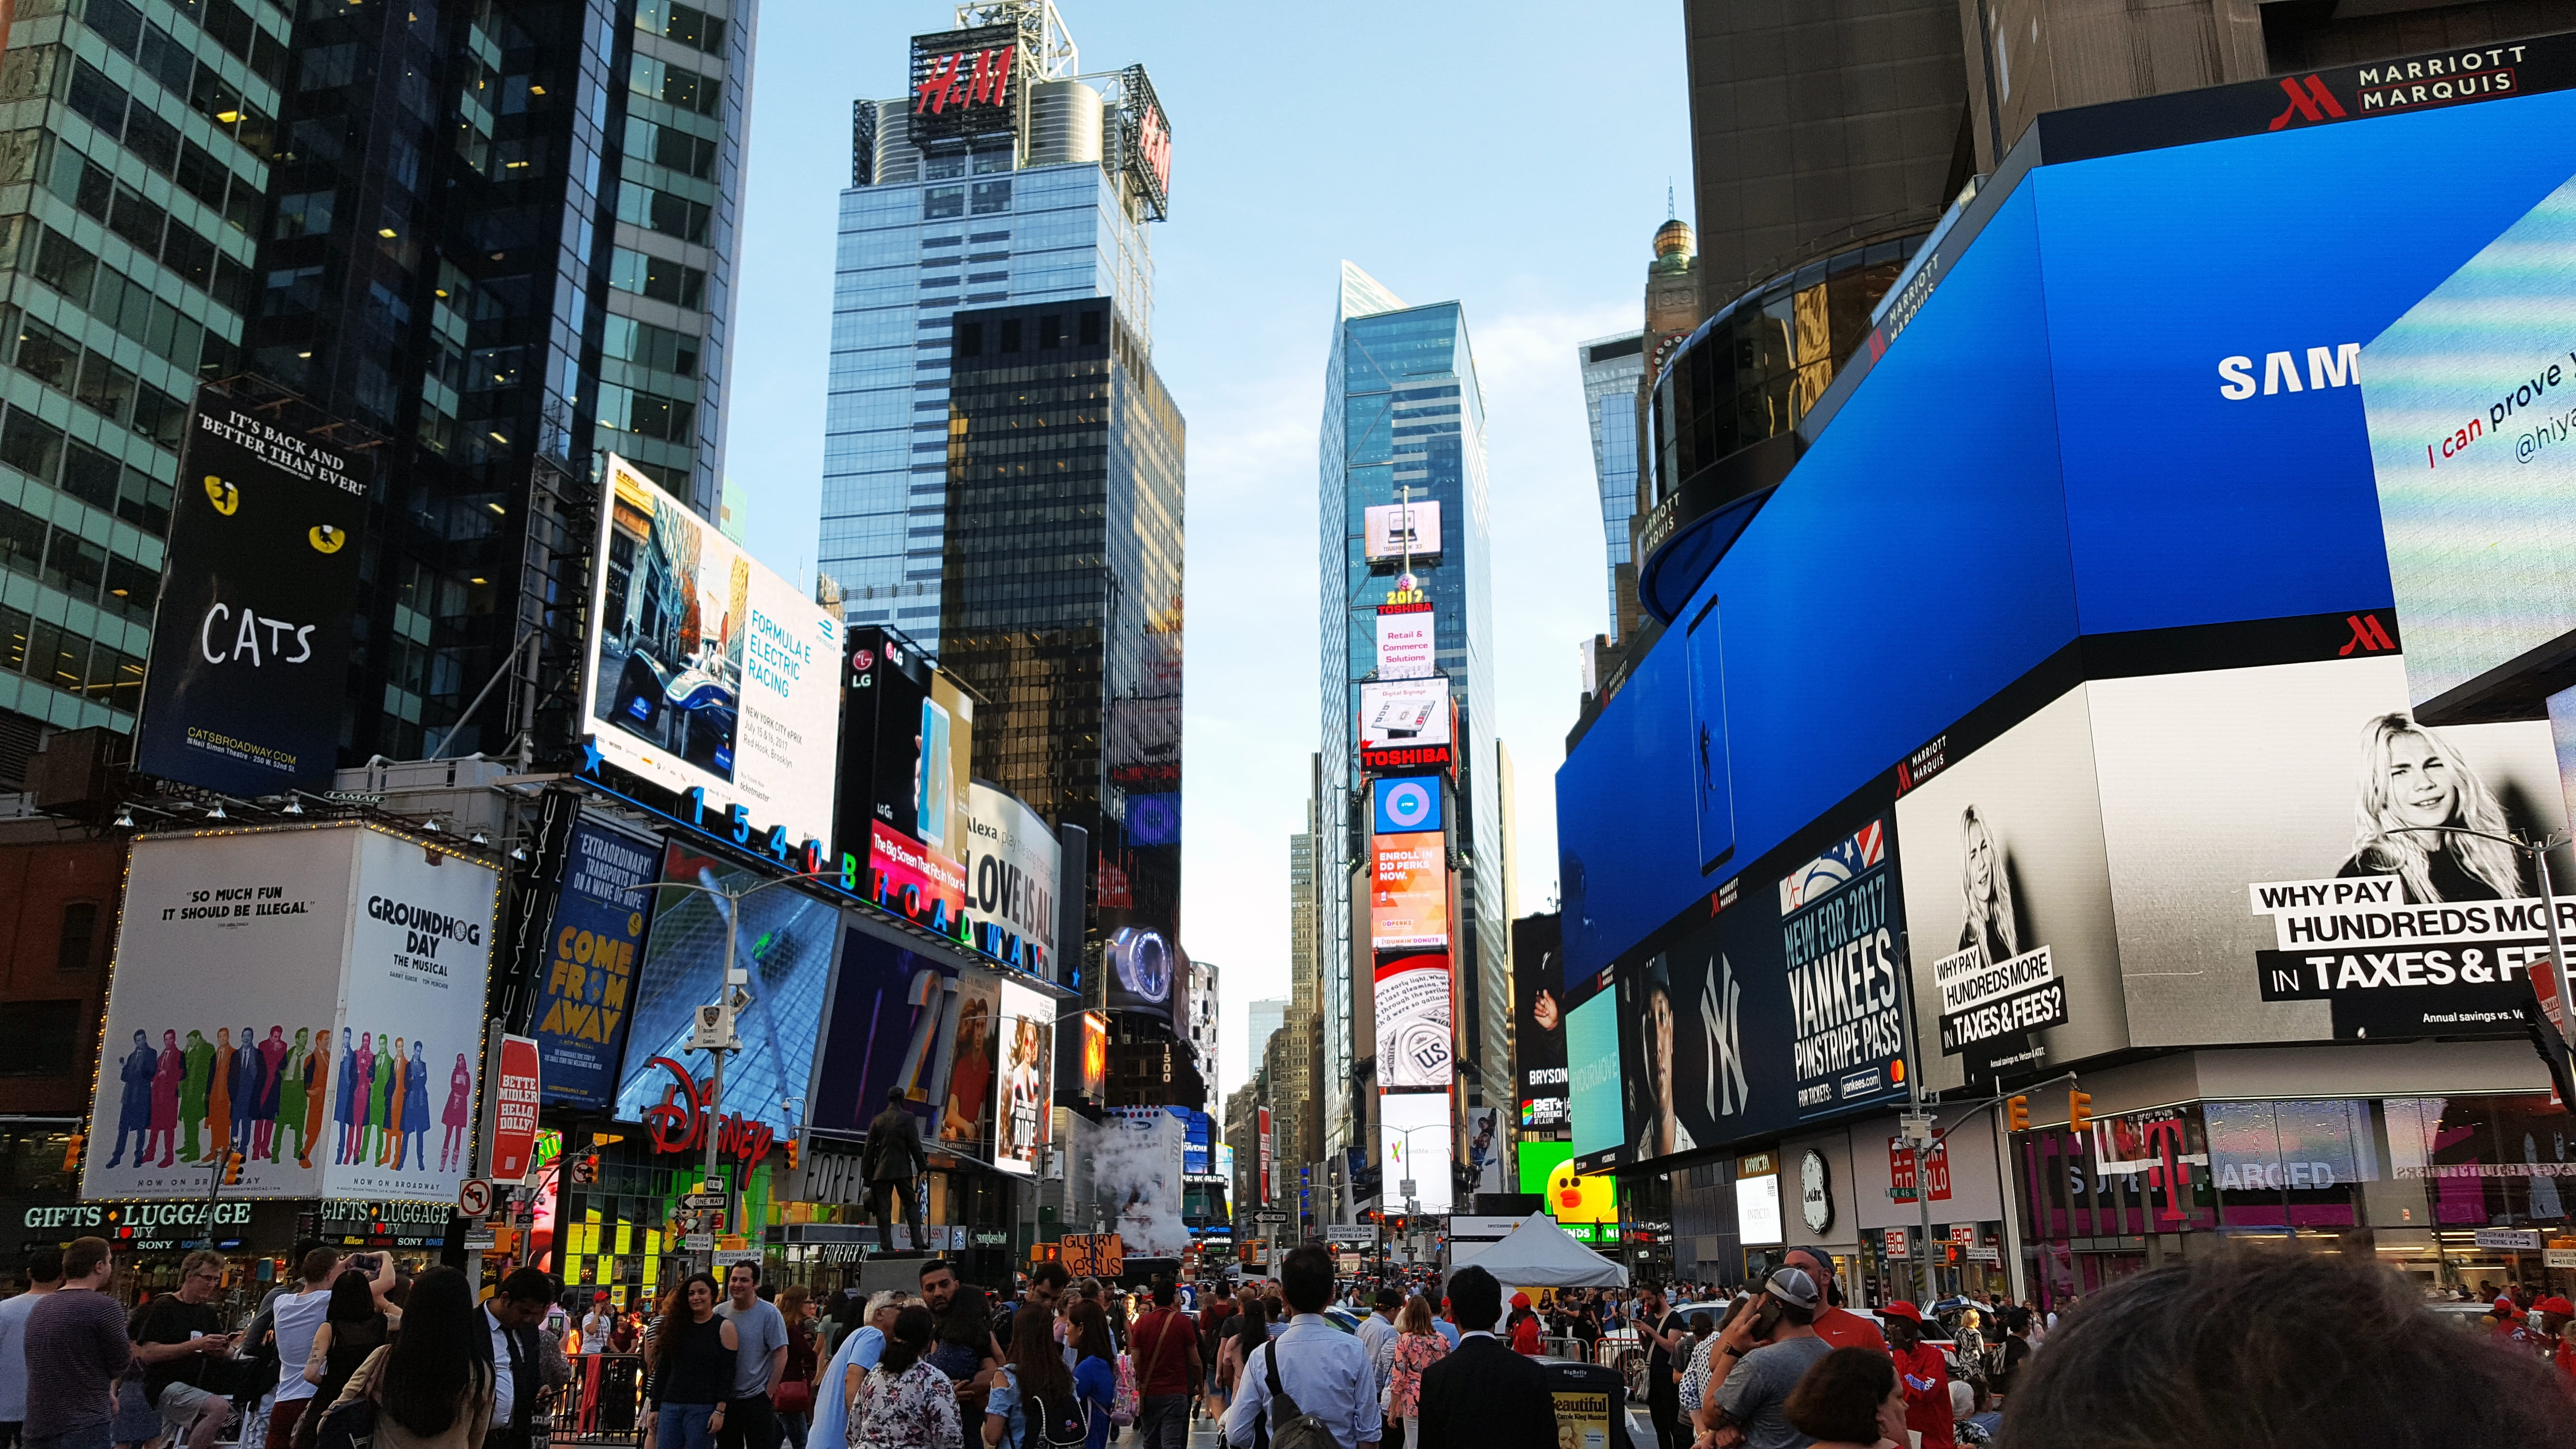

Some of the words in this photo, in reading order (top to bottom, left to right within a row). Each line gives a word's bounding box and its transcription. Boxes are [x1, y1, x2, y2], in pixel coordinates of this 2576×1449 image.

[2359, 46, 2527, 86] MARRIOTT
[917, 45, 1014, 114] H&M
[2364, 73, 2511, 110] MARQUIS
[1889, 253, 1939, 325] MARRIOTT
[2427, 445, 2434, 468] I
[2443, 418, 2482, 459] can
[2490, 364, 2561, 431] prove
[229, 411, 260, 434] IT'S
[264, 426, 307, 455] BACK
[310, 449, 344, 470] AND
[270, 445, 315, 475] THAN
[1642, 492, 1679, 538] MARRIOTT
[1377, 602, 1432, 614] TOSHIBA
[1386, 589, 1423, 604] 2017
[202, 603, 315, 667] CATS
[752, 609, 802, 659] FORMULA
[805, 645, 811, 664] E
[1383, 642, 1428, 650] Commerce
[1388, 631, 1414, 640] Retail
[750, 633, 800, 680] ELECTRIC
[893, 647, 903, 666] LG
[1386, 654, 1426, 663] Solutions
[749, 658, 789, 697] RACING
[853, 674, 871, 688] LG
[1403, 689, 1426, 697] Signage
[746, 705, 758, 721] NEW
[760, 713, 774, 729] YORK
[775, 722, 786, 736] CITY
[188, 727, 296, 764] CATSBROADWAY.COM
[744, 720, 756, 736] July
[757, 726, 762, 737] 15
[776, 737, 788, 751] 2017
[206, 742, 225, 753] Simon
[226, 747, 247, 760] Theatre
[253, 756, 264, 764] 250
[743, 733, 754, 747] Red
[771, 748, 792, 769] Brooklyn
[1363, 748, 1449, 767] TOSHIBA
[1912, 735, 1946, 767] MARRIOTT
[1914, 754, 1944, 782] MARQUIS
[330, 792, 380, 803] LAMAR
[740, 781, 769, 802] ticketmaster
[1002, 829, 1016, 853] play
[874, 833, 886, 851] The
[886, 839, 897, 862] Big
[897, 846, 917, 868] Screen
[917, 857, 930, 874] That
[931, 864, 940, 880] Fits
[946, 872, 959, 889] Your
[1380, 851, 1419, 861] ENROLL
[1423, 850, 1433, 859] IN
[1380, 862, 1394, 870] DD
[1397, 860, 1429, 869] PERKS
[586, 857, 629, 886] TRANSPORTS
[1380, 871, 1408, 881] NOW.
[215, 888, 253, 901] MUCH
[258, 886, 283, 898] FUN
[574, 872, 585, 890] ON
[585, 876, 591, 892] A
[592, 878, 614, 900] WAVE
[1720, 877, 1738, 897] MARRIOTT
[2259, 885, 2329, 908] WHY
[2335, 881, 2393, 905] PAY
[964, 849, 1021, 925] LOVE
[1023, 874, 1034, 934] IS
[1036, 887, 1054, 950] ALL
[1721, 890, 1738, 908] MARQUIS
[162, 908, 175, 920] IT
[181, 905, 230, 919] SHOULD
[234, 904, 250, 916] BE
[368, 896, 480, 946] GROUNDHOG
[1784, 914, 1815, 970] NEW
[1819, 897, 1848, 949] FOR
[1850, 873, 1885, 938] 2017
[2288, 908, 2490, 943] HUNDREDS
[406, 930, 440, 959] DAY
[558, 926, 634, 976] COME
[394, 954, 409, 967] THE
[412, 959, 448, 976] MUSICAL
[1937, 957, 1959, 981] WHY
[1960, 950, 1977, 973] PAY
[2272, 970, 2300, 992] IN
[2306, 950, 2455, 989] TAXES
[2462, 949, 2495, 983] &
[1391, 981, 1408, 990] early
[1788, 927, 1896, 1040] YANKEES
[1947, 967, 2009, 1008] HUNDREDS
[2010, 952, 2048, 987] MORE
[1382, 996, 1409, 1013] through
[1385, 992, 1400, 1002] last
[539, 998, 621, 1044] AWAY
[1392, 1006, 1409, 1017] were
[1944, 1029, 1953, 1049] IN
[1953, 1005, 2000, 1045] TAXES
[2001, 1002, 2013, 1032] &
[2012, 985, 2061, 1029] FEES?
[2423, 1012, 2457, 1023] Annual
[2459, 1013, 2496, 1023] savings
[1415, 1043, 1448, 1069] US
[1794, 1018, 1862, 1082] PINSTRIPE
[1863, 1008, 1901, 1062] PASS
[502, 1075, 536, 1089] BETTE
[1530, 1068, 1568, 1085] BRYSON
[1843, 1075, 1878, 1096] yankees.com
[499, 1088, 538, 1103] MIDLER
[1533, 1098, 1557, 1111] BET
[1799, 1088, 1808, 1108] FOR
[1808, 1083, 1832, 1105] TICKETS:
[500, 1103, 534, 1119] HELLO,
[500, 1115, 533, 1132] DOLLY!
[1015, 1119, 1035, 1146] RIDE
[1745, 1154, 1770, 1174] INVICTA
[395, 1180, 440, 1191] BROADWAY
[1900, 1189, 1910, 1197] 46
[24, 1207, 101, 1228] GIFTS
[122, 1203, 251, 1226] LUGGAGE
[321, 1201, 368, 1222] GIFTS
[380, 1203, 451, 1225] LUGGAGE
[137, 1240, 175, 1249] SONY
[343, 1236, 364, 1245] Nikon
[368, 1237, 393, 1246] Canon
[977, 1230, 998, 1248] sunglass
[998, 1230, 1007, 1244] hut
[1063, 1234, 1114, 1249] GLORY
[824, 1244, 861, 1261] FOREVER
[1081, 1246, 1104, 1260] IN
